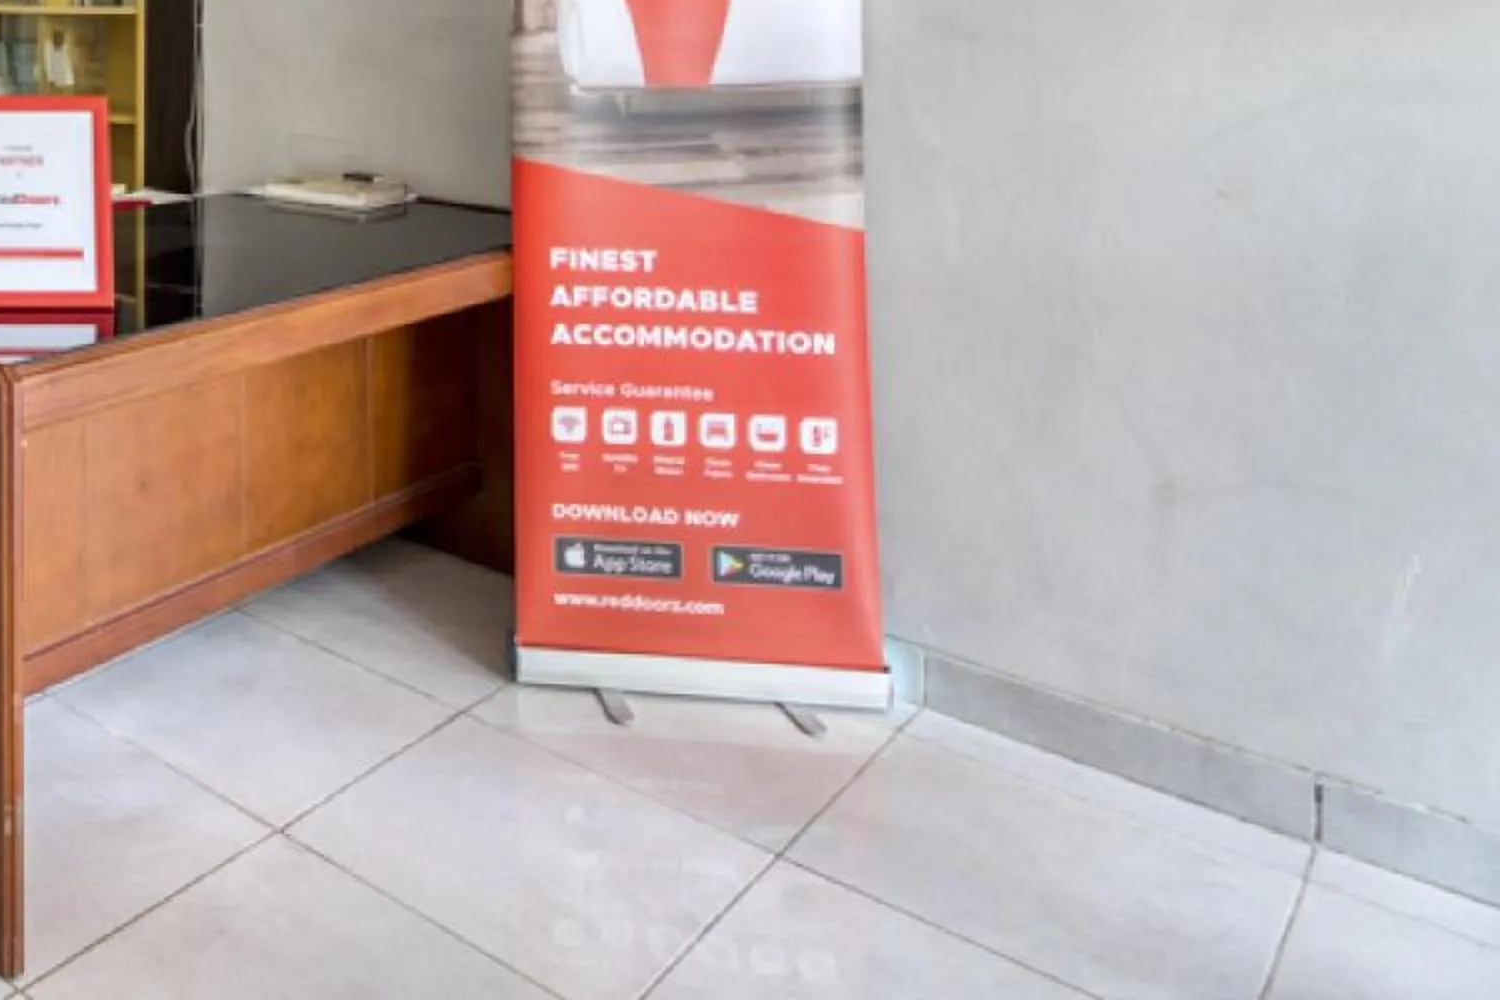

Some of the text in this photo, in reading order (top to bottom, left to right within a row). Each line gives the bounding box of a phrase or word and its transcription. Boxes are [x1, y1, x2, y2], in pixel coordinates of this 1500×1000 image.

[550, 247, 658, 272] FINEST
[550, 284, 759, 314] AFFORDABLE
[550, 323, 837, 356] ACCOMMODATION
[550, 379, 715, 402] Service Guarantee
[552, 502, 741, 528] DOWNLOAD NOW
[593, 554, 674, 575] App Store
[749, 562, 836, 586] Google Play
[553, 592, 726, 616] www.reddoorz.com
